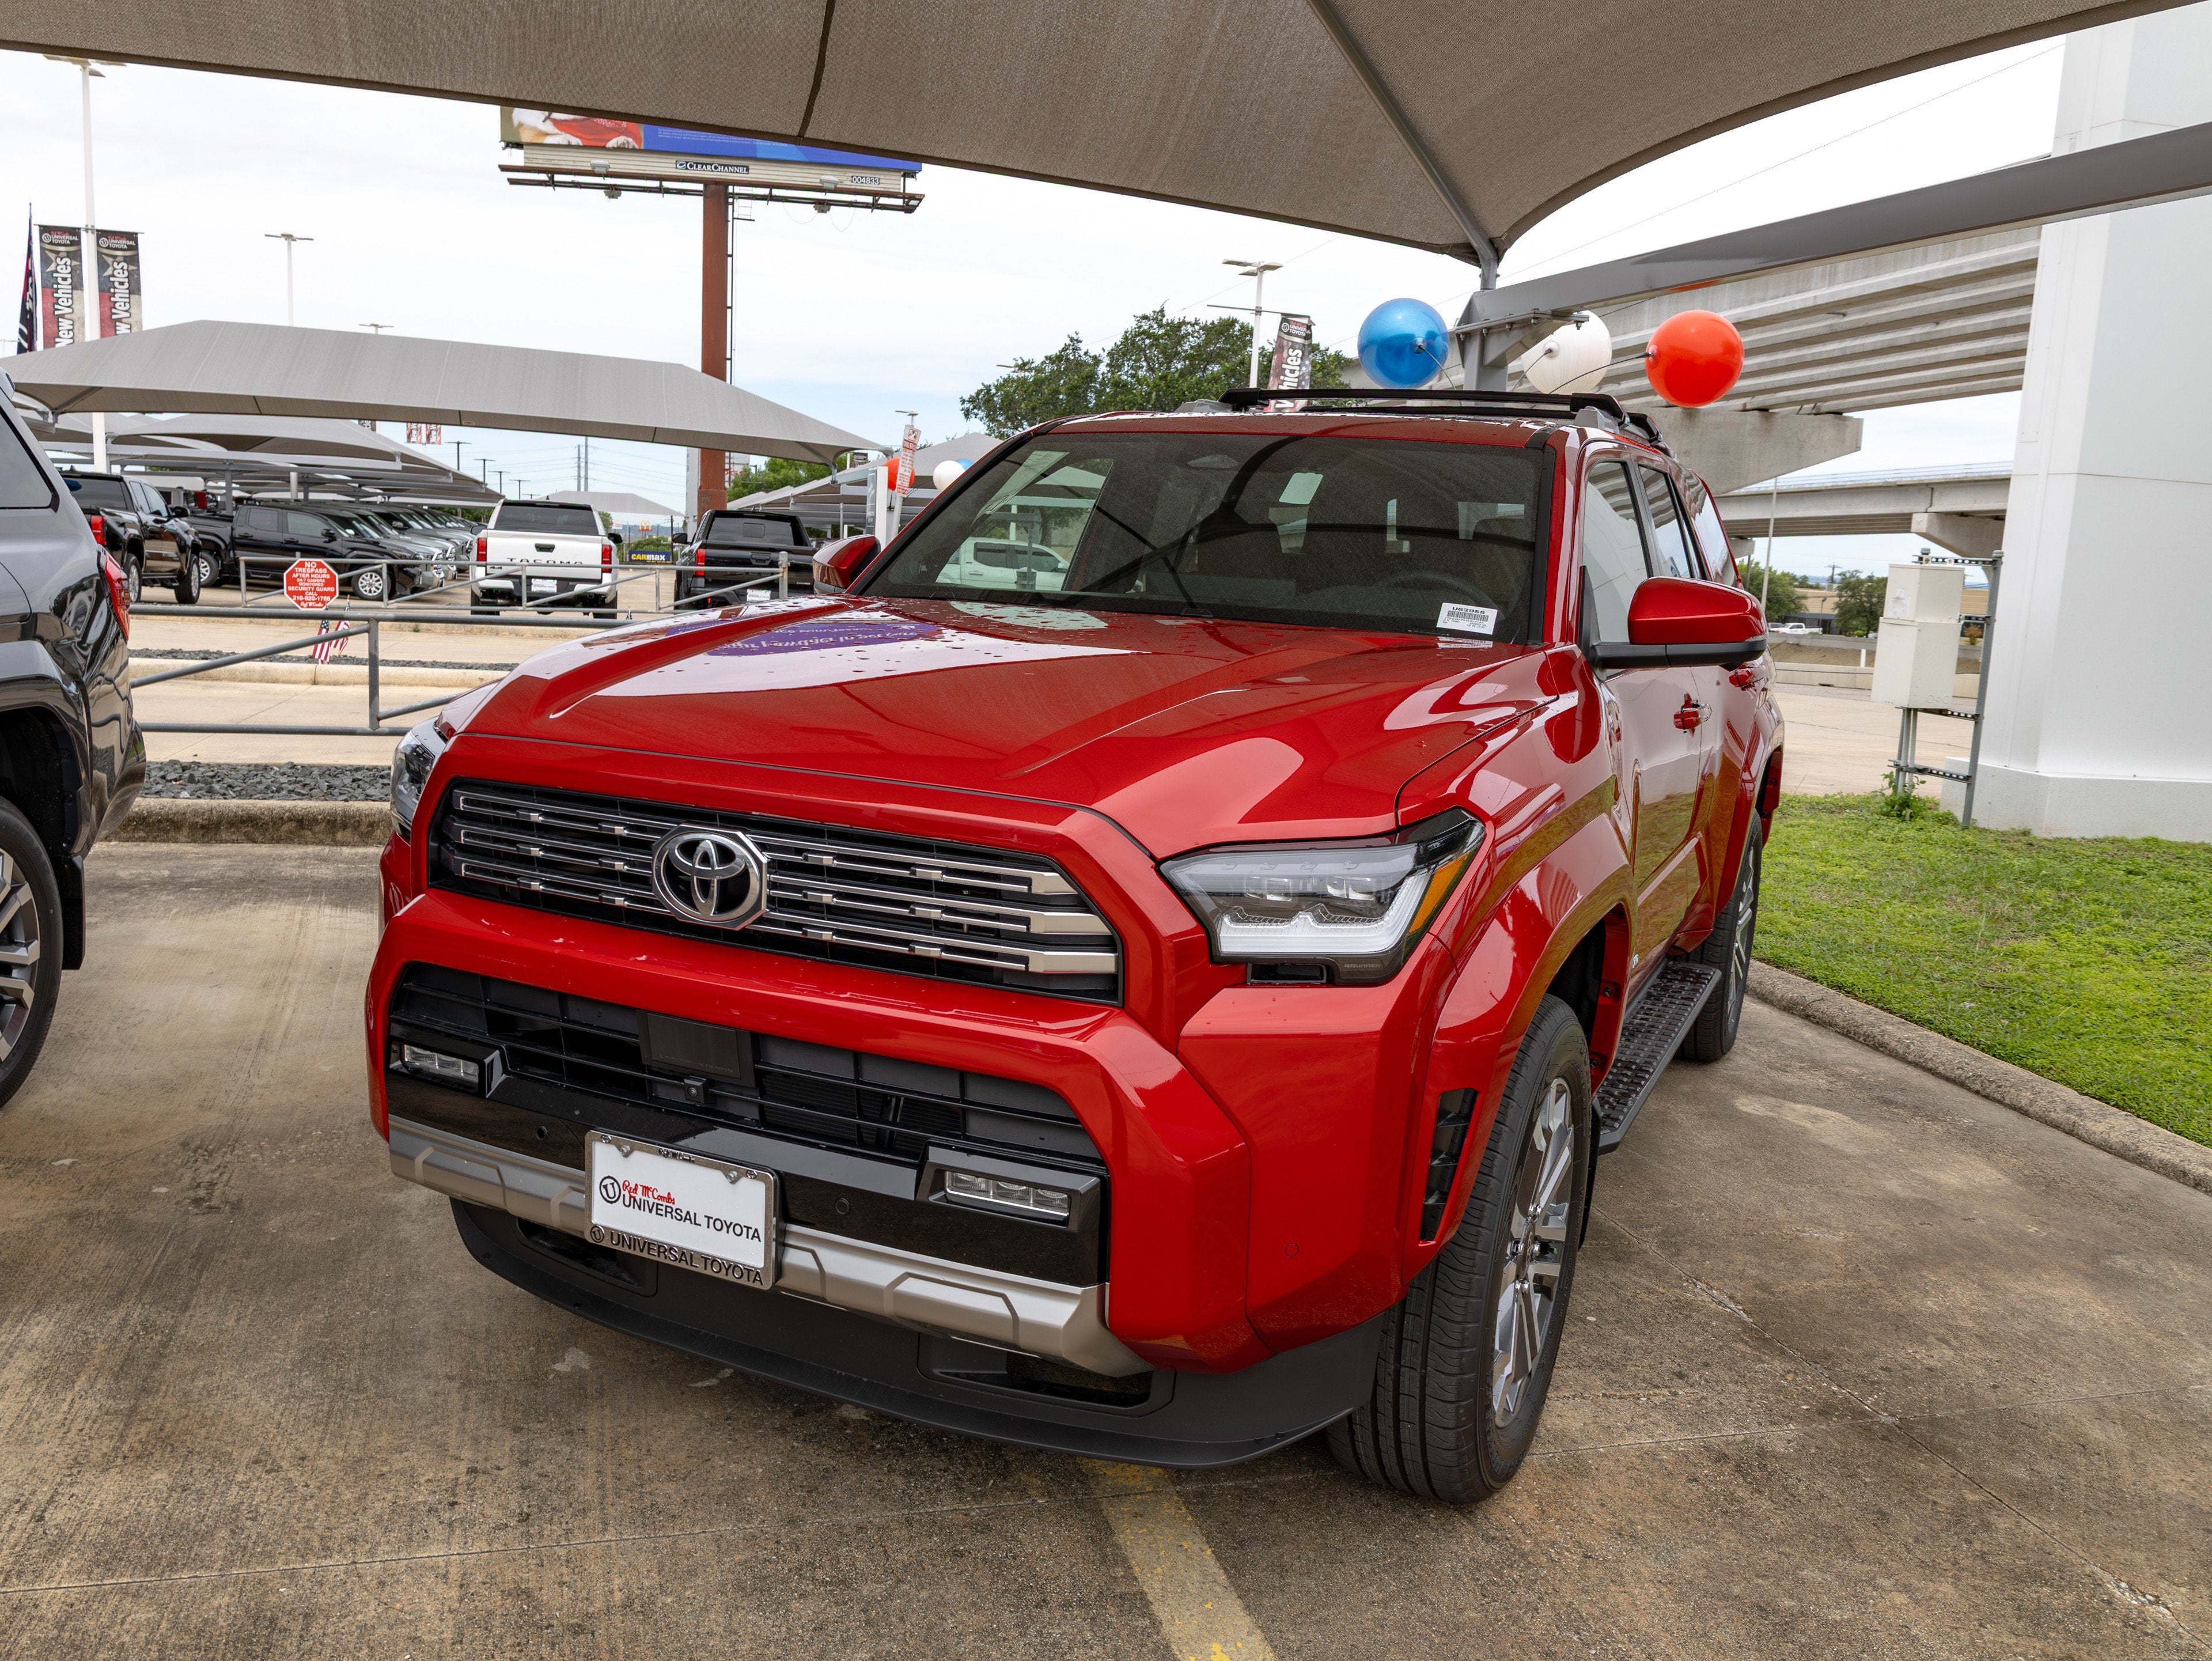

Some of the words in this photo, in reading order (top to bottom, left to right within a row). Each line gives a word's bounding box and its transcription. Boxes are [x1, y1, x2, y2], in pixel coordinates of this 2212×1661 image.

[853, 176, 879, 184] 004833
[53, 257, 73, 315] Vehicles
[110, 262, 131, 319] Vehicles
[622, 1180, 638, 1198] Red
[639, 1184, 675, 1205] McCombs
[622, 1193, 702, 1227] UNIVERSAL
[704, 1214, 762, 1242] TOYOTA
[609, 1231, 699, 1268] UNIVERSAL
[700, 1255, 764, 1285] TOYOTA
